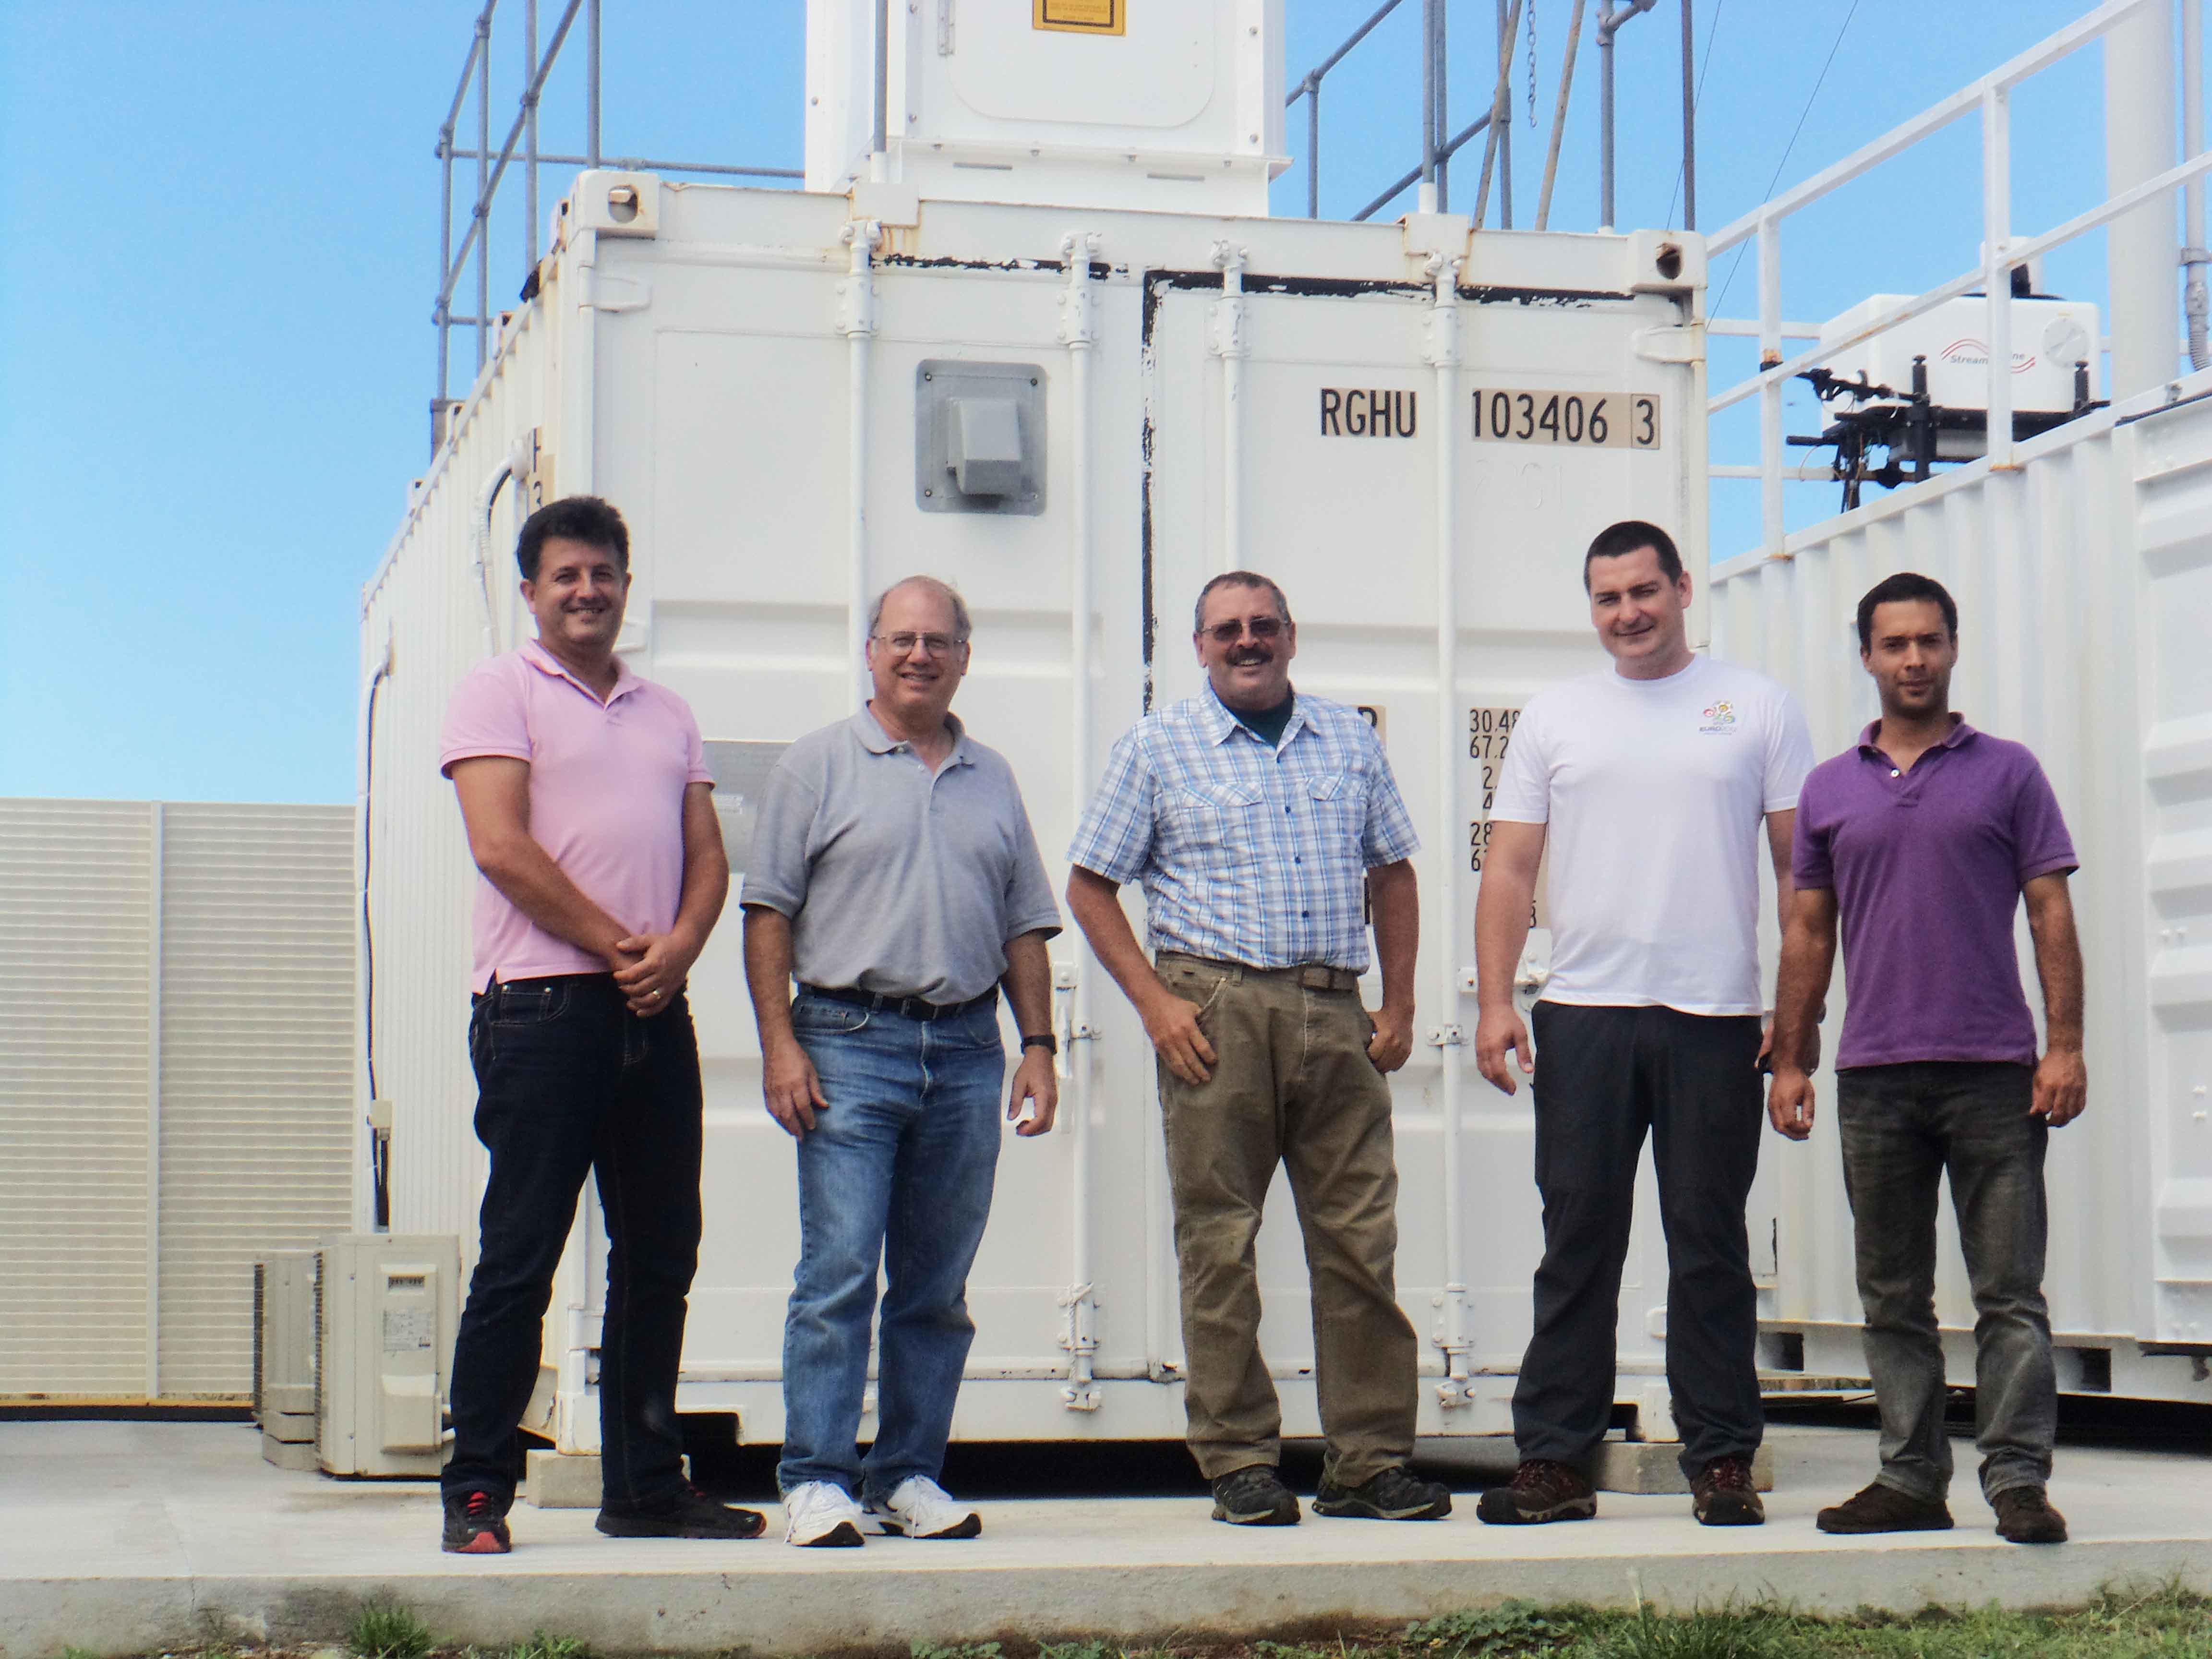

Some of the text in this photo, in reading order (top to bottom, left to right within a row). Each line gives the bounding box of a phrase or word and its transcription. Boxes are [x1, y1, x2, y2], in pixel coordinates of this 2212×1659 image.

[1321, 389, 1655, 445] RGHU 103406 3
[1471, 848, 1487, 871] 6
